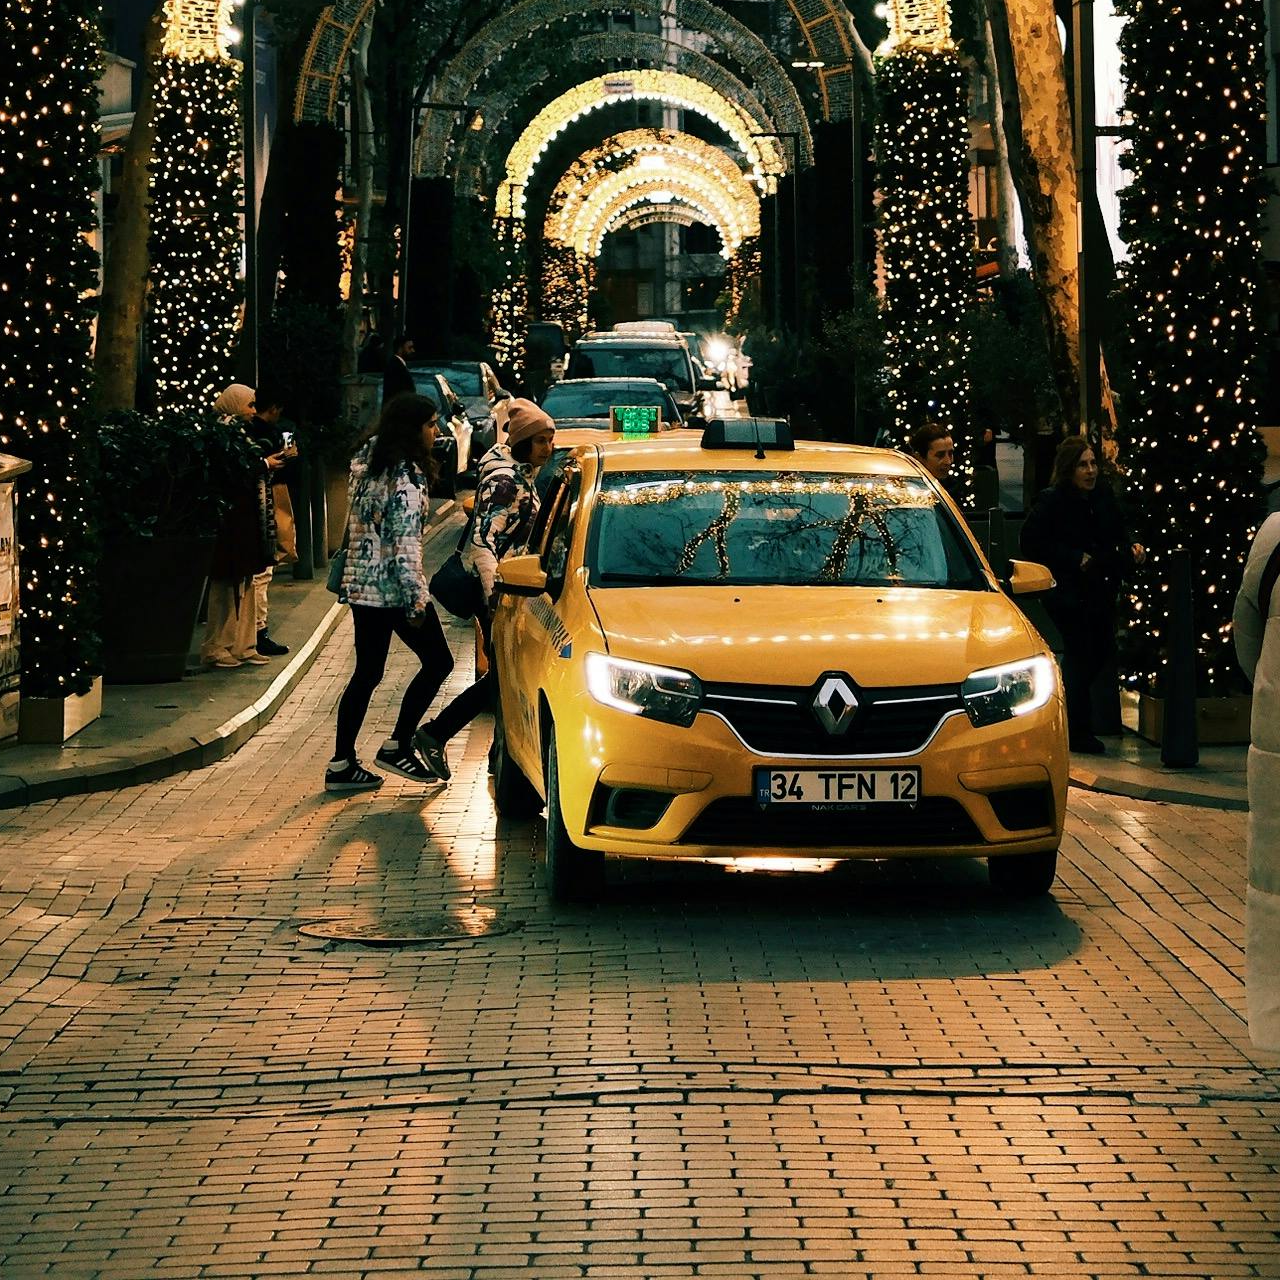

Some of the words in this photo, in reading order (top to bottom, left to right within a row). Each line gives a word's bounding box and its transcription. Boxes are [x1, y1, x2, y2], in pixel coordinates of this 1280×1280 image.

[759, 788, 770, 797] TR
[771, 772, 804, 801] 34
[817, 772, 876, 801] TFN
[889, 772, 917, 800] 12
